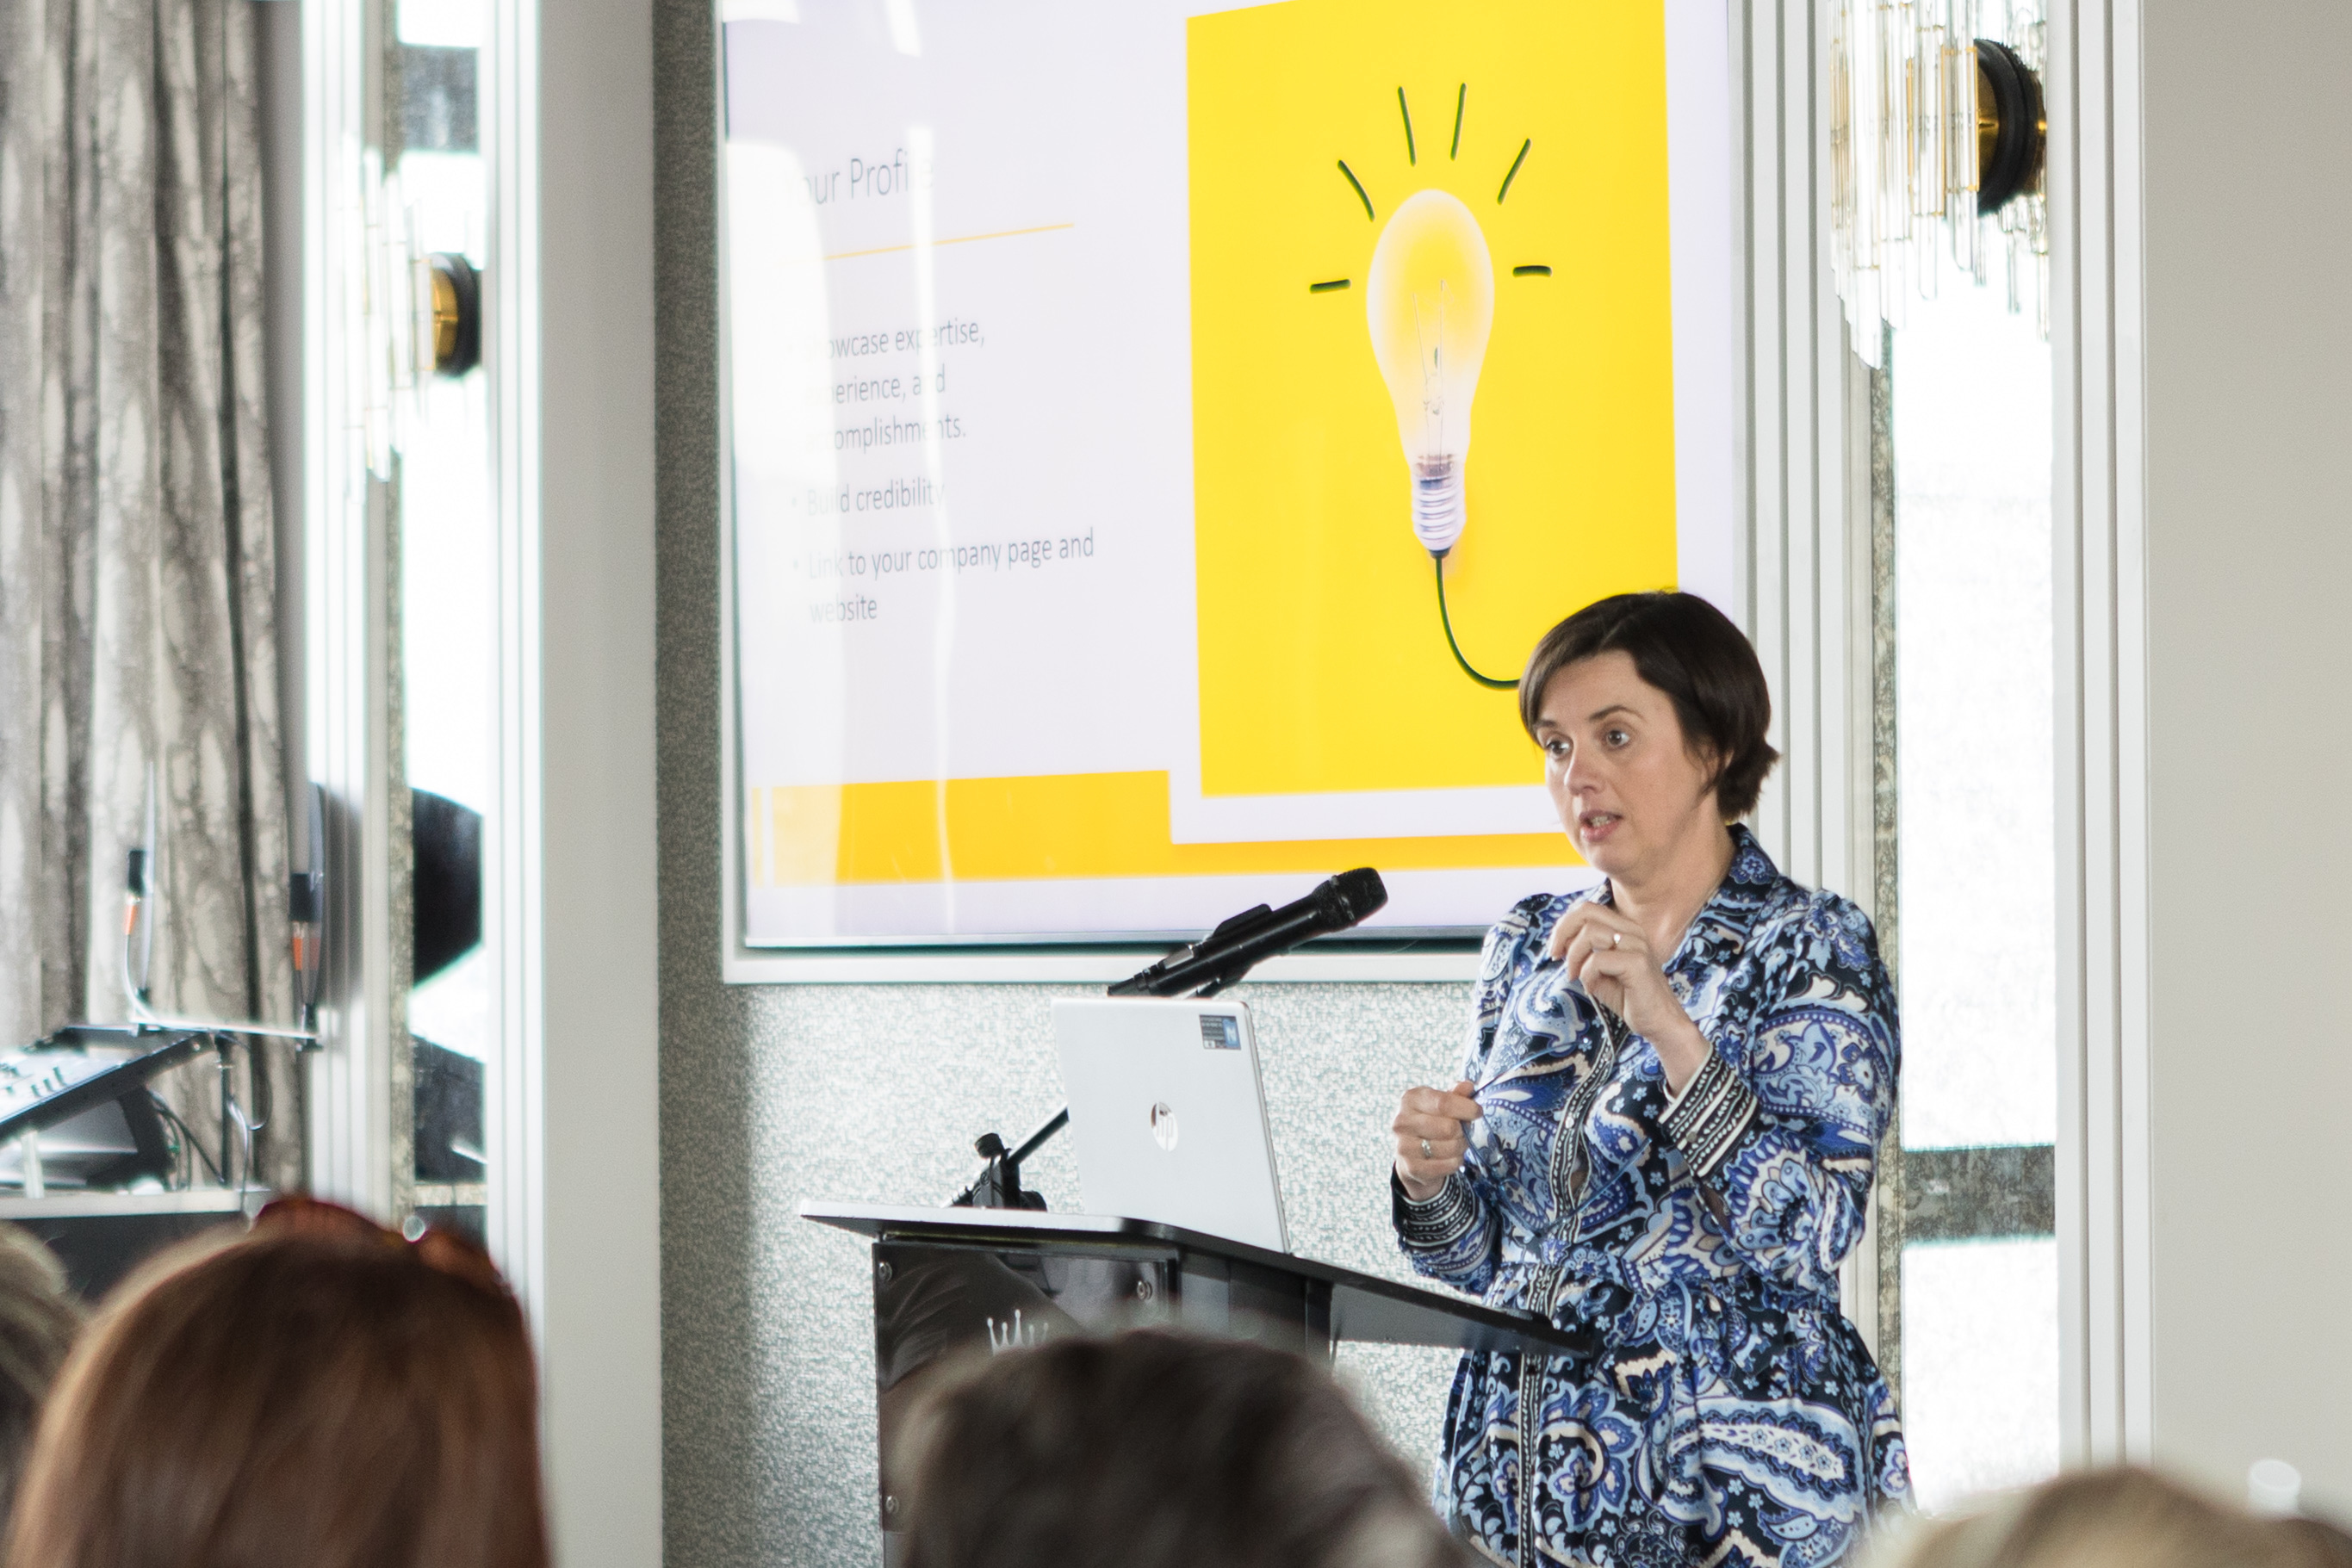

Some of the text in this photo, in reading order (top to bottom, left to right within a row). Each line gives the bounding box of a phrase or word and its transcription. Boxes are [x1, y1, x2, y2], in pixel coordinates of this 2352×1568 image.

[790, 147, 934, 205] our Profie
[813, 332, 889, 359] owcase
[818, 363, 946, 406] erience, ad
[818, 413, 966, 454] omplishments.
[856, 477, 945, 512] credibility
[848, 549, 866, 576] to
[872, 549, 912, 581] your
[918, 541, 1002, 573] company
[1008, 537, 1052, 569] page
[1058, 526, 1094, 559] and
[810, 592, 878, 624] website
